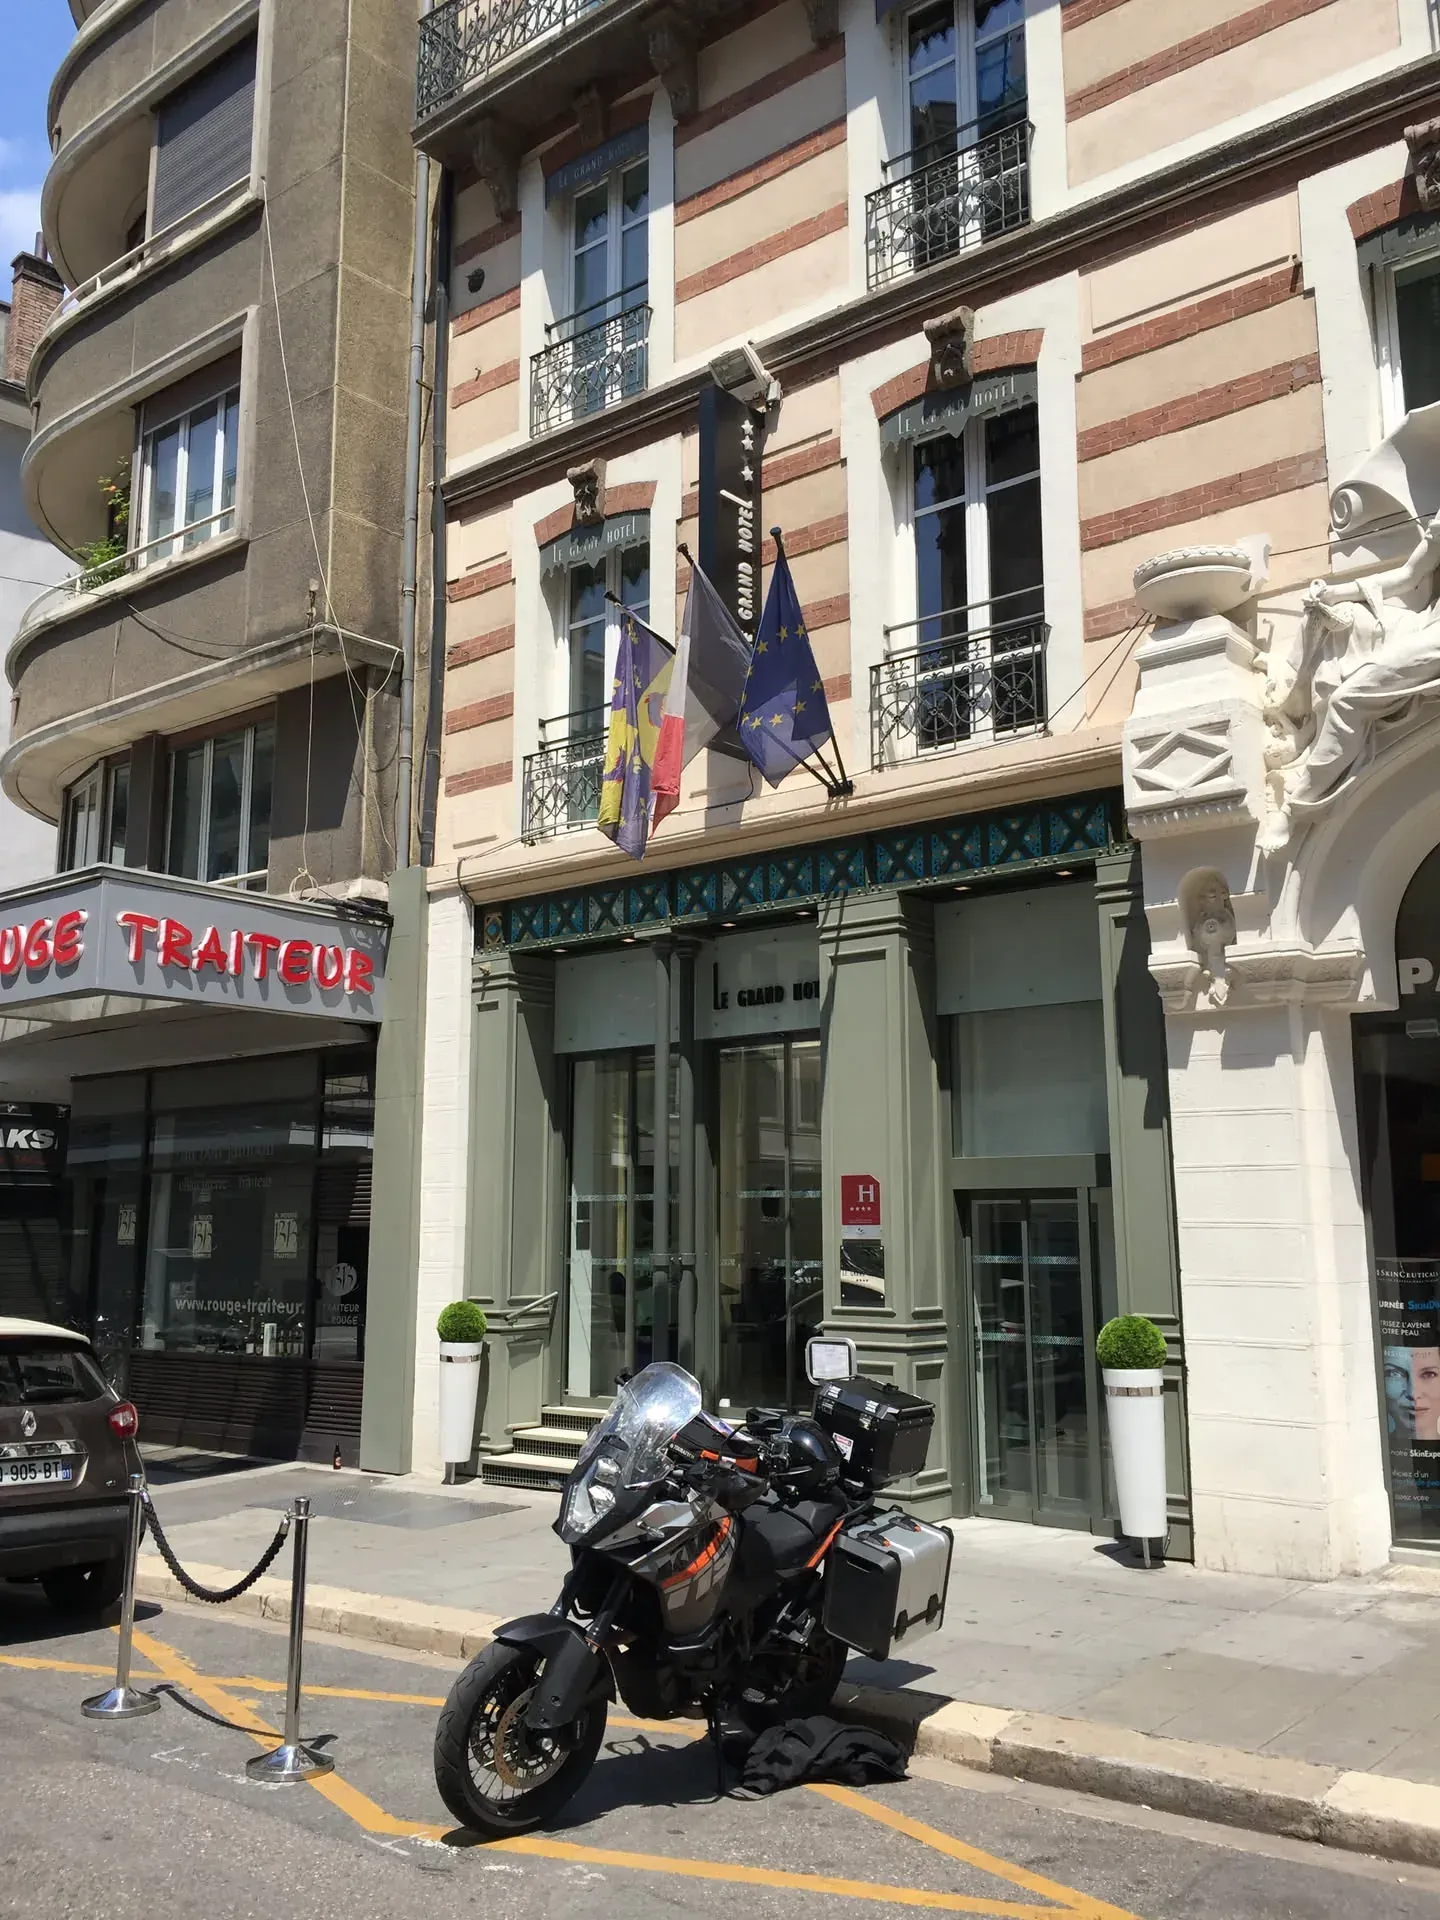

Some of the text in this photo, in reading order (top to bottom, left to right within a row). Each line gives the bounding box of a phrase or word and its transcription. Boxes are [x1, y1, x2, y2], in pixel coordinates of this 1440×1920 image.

[897, 412, 911, 435] LE
[974, 373, 1016, 408] HOTEL
[552, 543, 563, 563] LE
[606, 515, 636, 543] HOTEL
[719, 488, 756, 554] HOTEL
[738, 562, 754, 621] GRAND
[116, 910, 376, 996] TRAITEUR
[1398, 957, 1440, 995] P
[712, 961, 729, 1011] LE
[736, 985, 785, 1008] GRAND
[0, 1128, 55, 1150] KS
[857, 1183, 876, 1203] H
